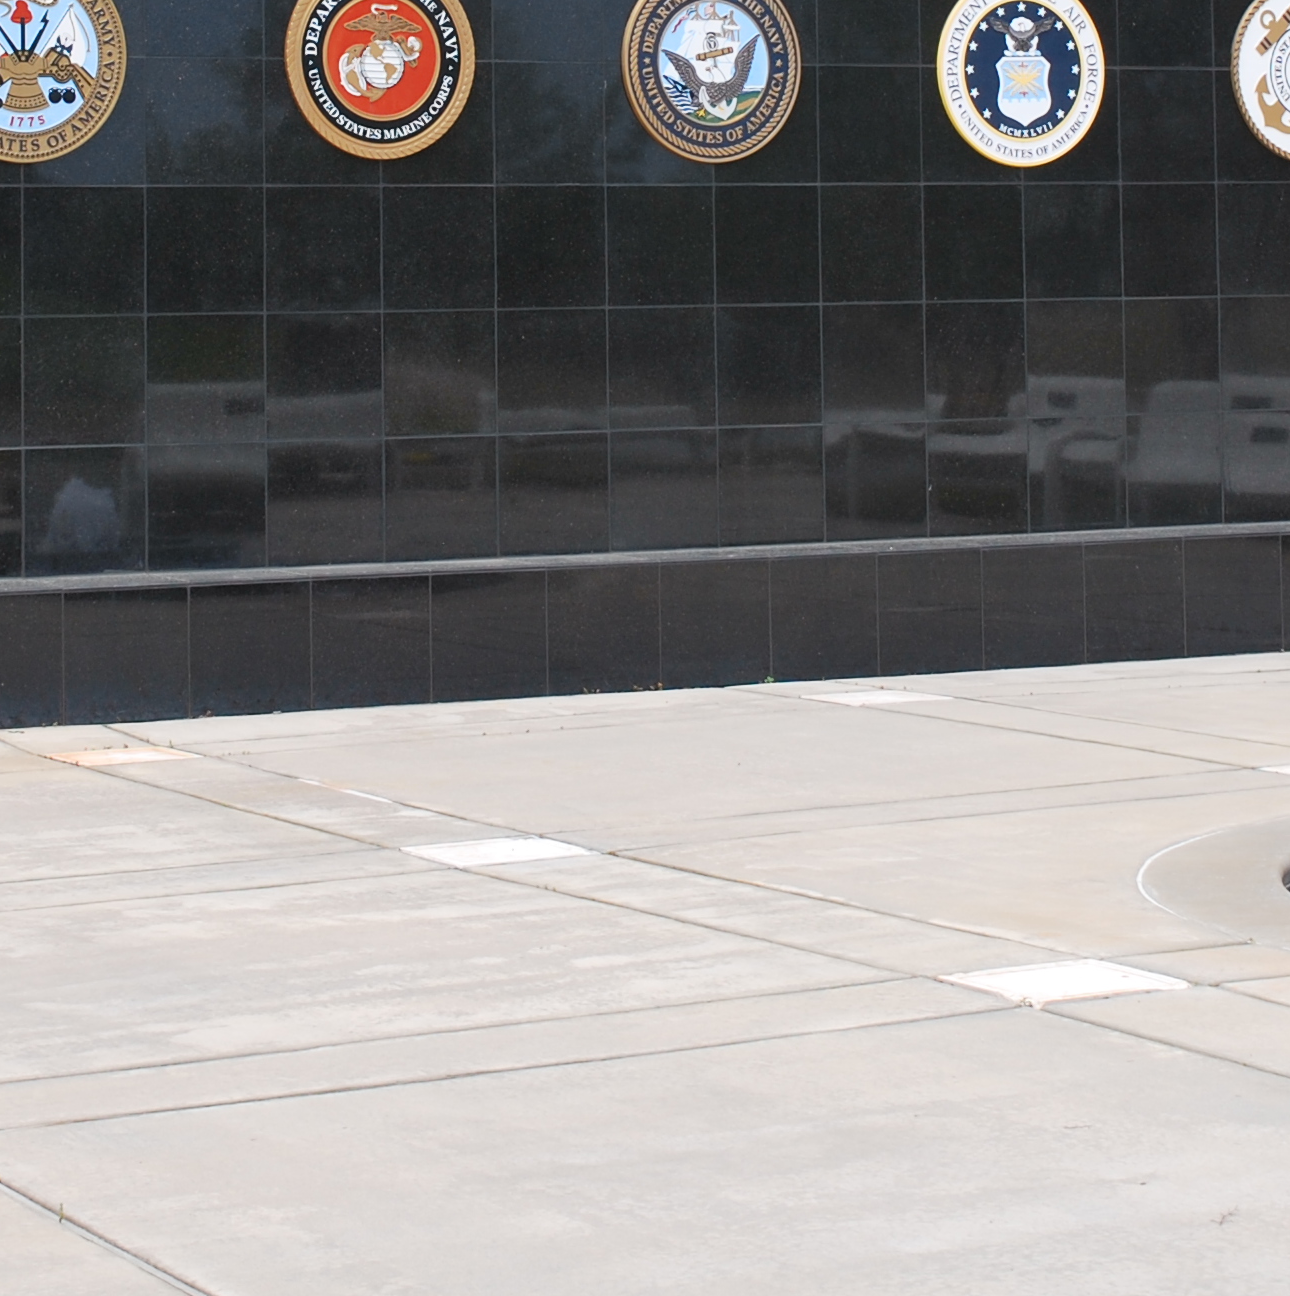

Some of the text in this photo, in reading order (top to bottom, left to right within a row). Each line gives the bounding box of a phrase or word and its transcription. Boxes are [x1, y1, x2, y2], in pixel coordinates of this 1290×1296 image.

[86, 0, 116, 48] ARMY
[434, 9, 458, 63] NAVY
[760, 15, 784, 55] NAVY
[1063, 6, 1087, 35] AIR
[1083, 43, 1098, 103] FORCE
[1274, 56, 1290, 102] UNITED
[9, 115, 46, 128] 1775
[47, 132, 68, 149] OF
[71, 61, 116, 137] AMERICA
[309, 67, 453, 140] UNITED STATES MARINE CORPS
[642, 68, 784, 144] UNITED STATES OF AMERICA
[960, 110, 1088, 158] UNITED STATES OF AMERICA
[998, 121, 1054, 138] MCMXLVII
